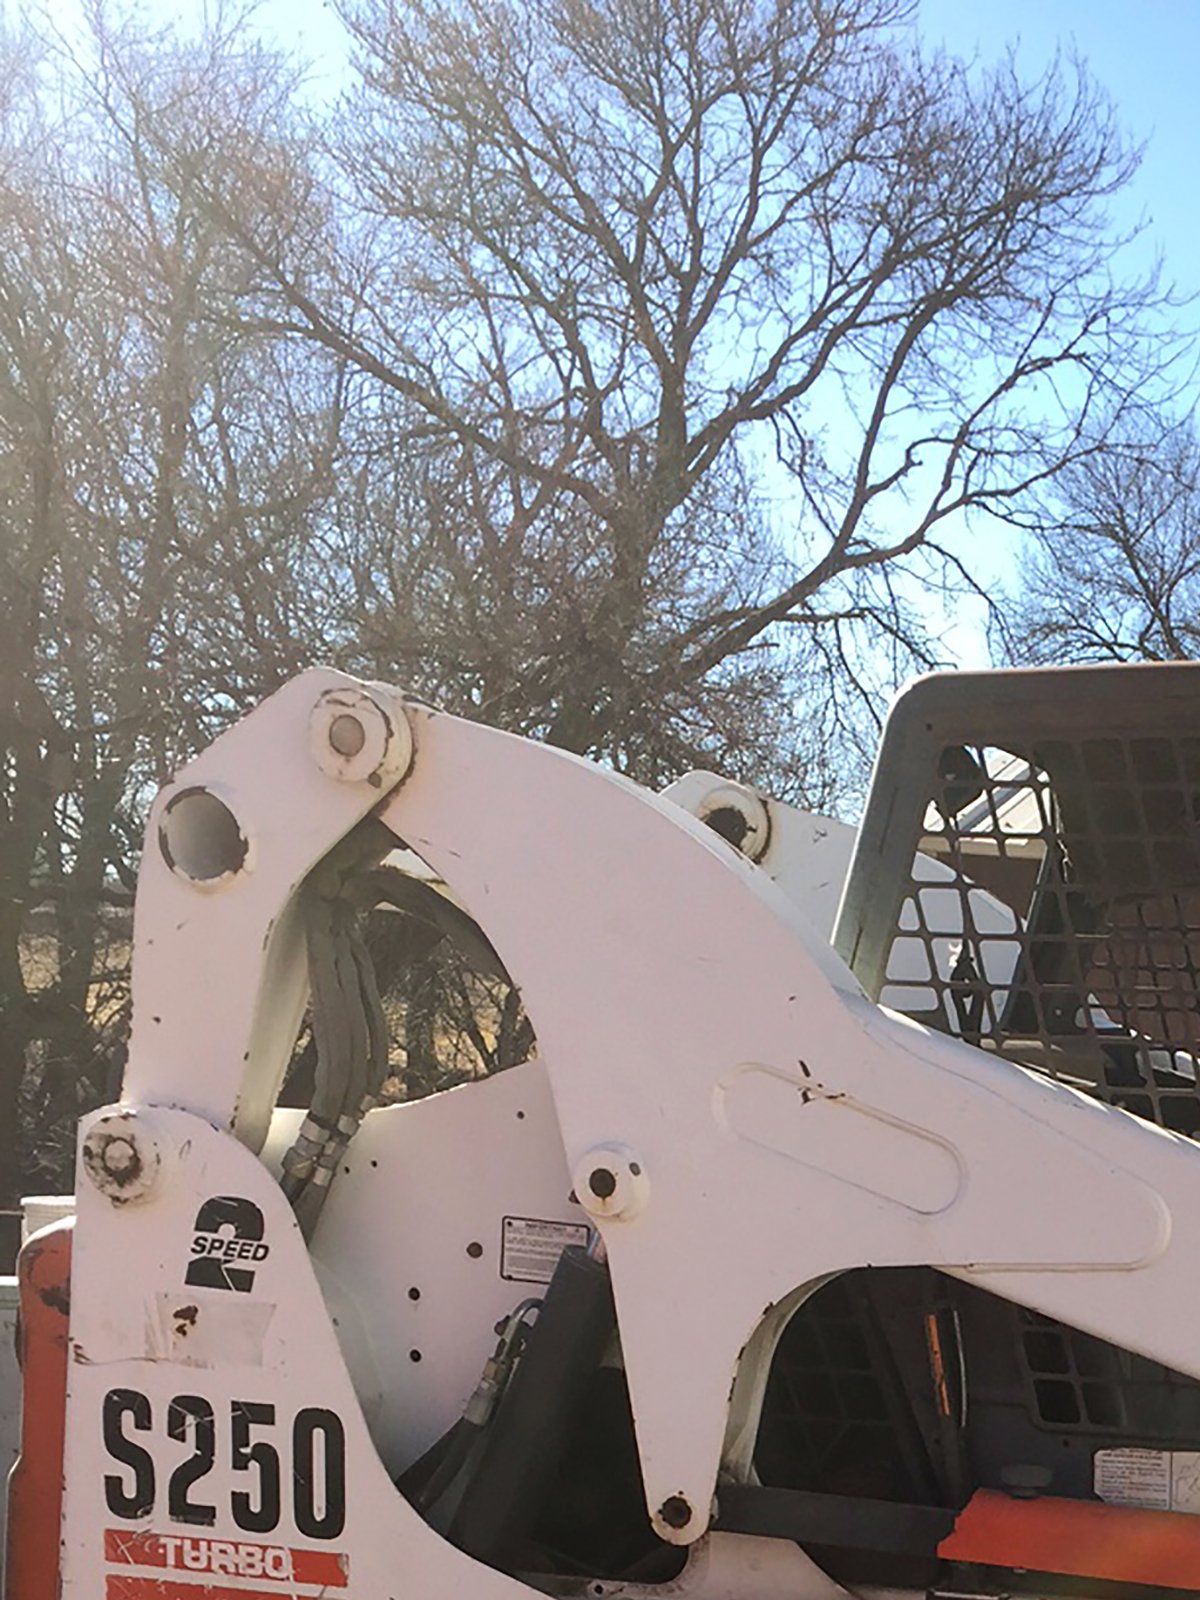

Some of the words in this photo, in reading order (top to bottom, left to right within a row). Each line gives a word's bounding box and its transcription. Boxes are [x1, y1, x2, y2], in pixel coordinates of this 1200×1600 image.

[184, 1196, 264, 1293] 2
[190, 1236, 269, 1261] SPEED
[102, 1388, 346, 1540] S250
[157, 1536, 293, 1580] TURBO
